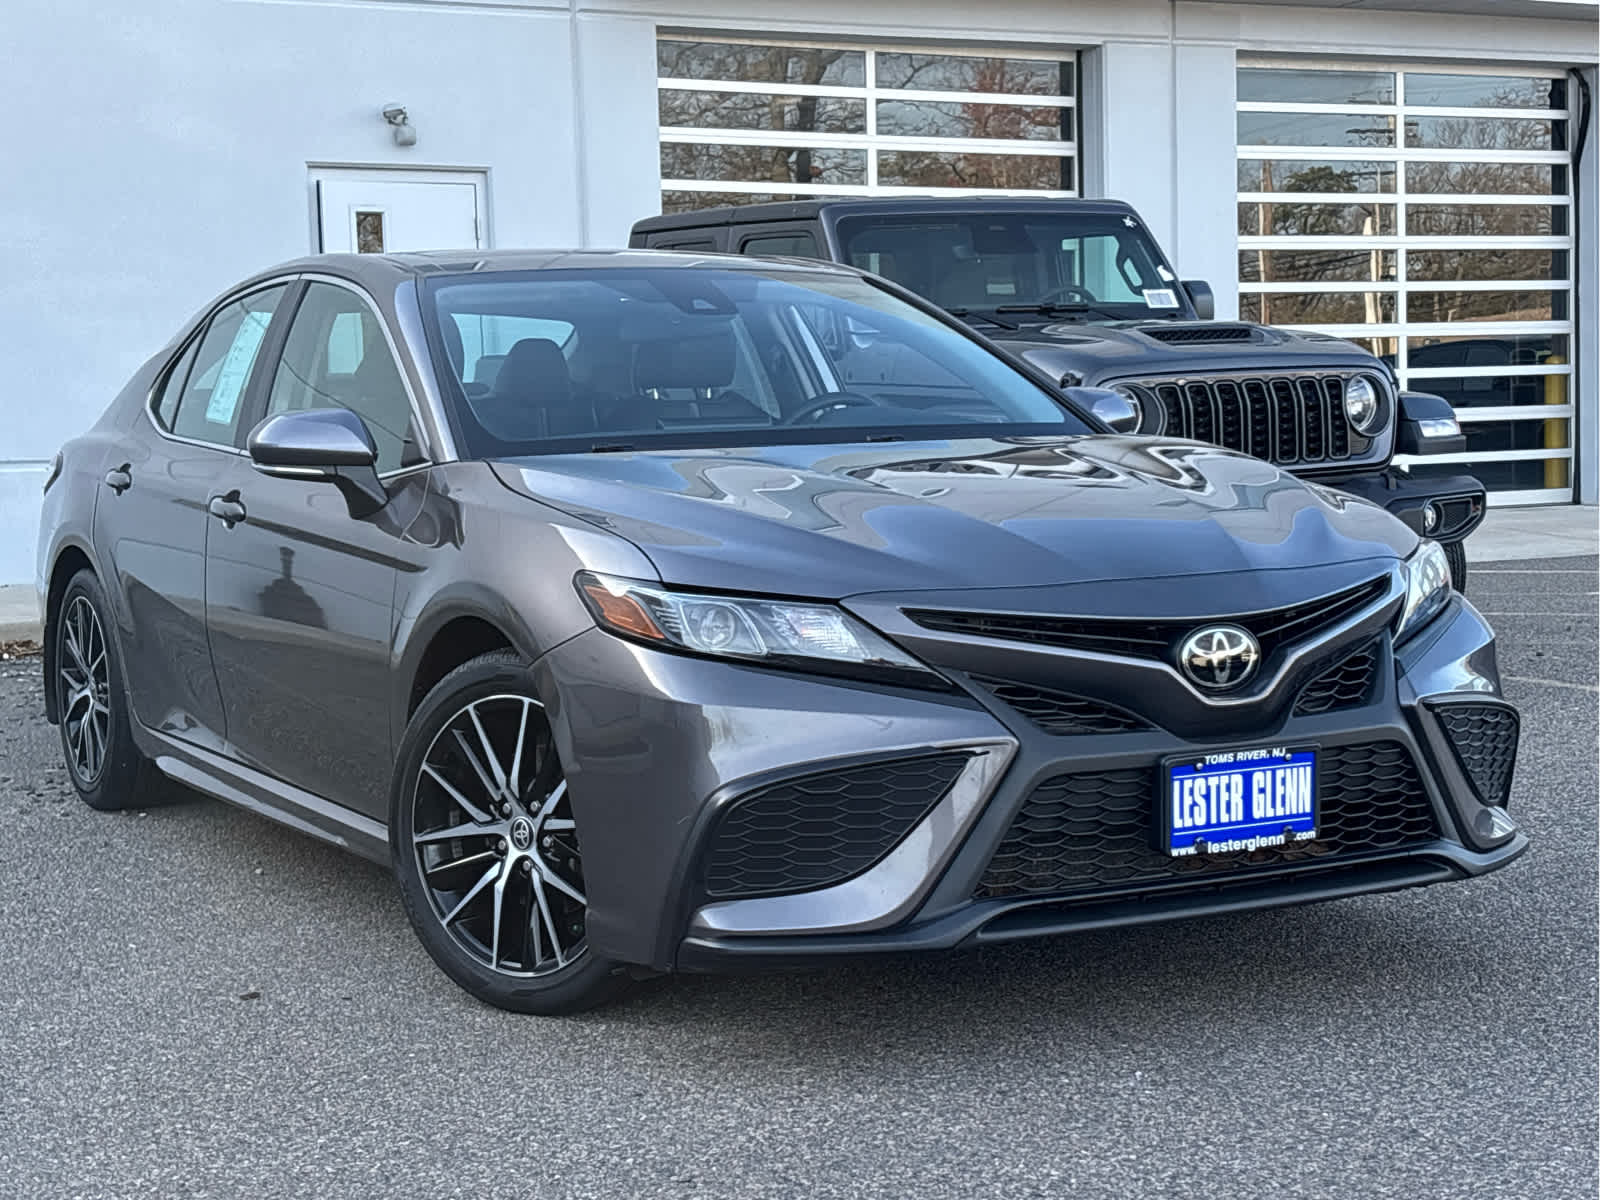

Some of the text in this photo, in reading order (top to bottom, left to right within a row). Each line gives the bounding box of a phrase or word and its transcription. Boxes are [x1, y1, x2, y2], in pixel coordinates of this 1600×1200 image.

[1205, 754, 1234, 765] TOMS
[1173, 766, 1311, 828] LESTER GLENN
[1208, 835, 1285, 853] lesterglenn
